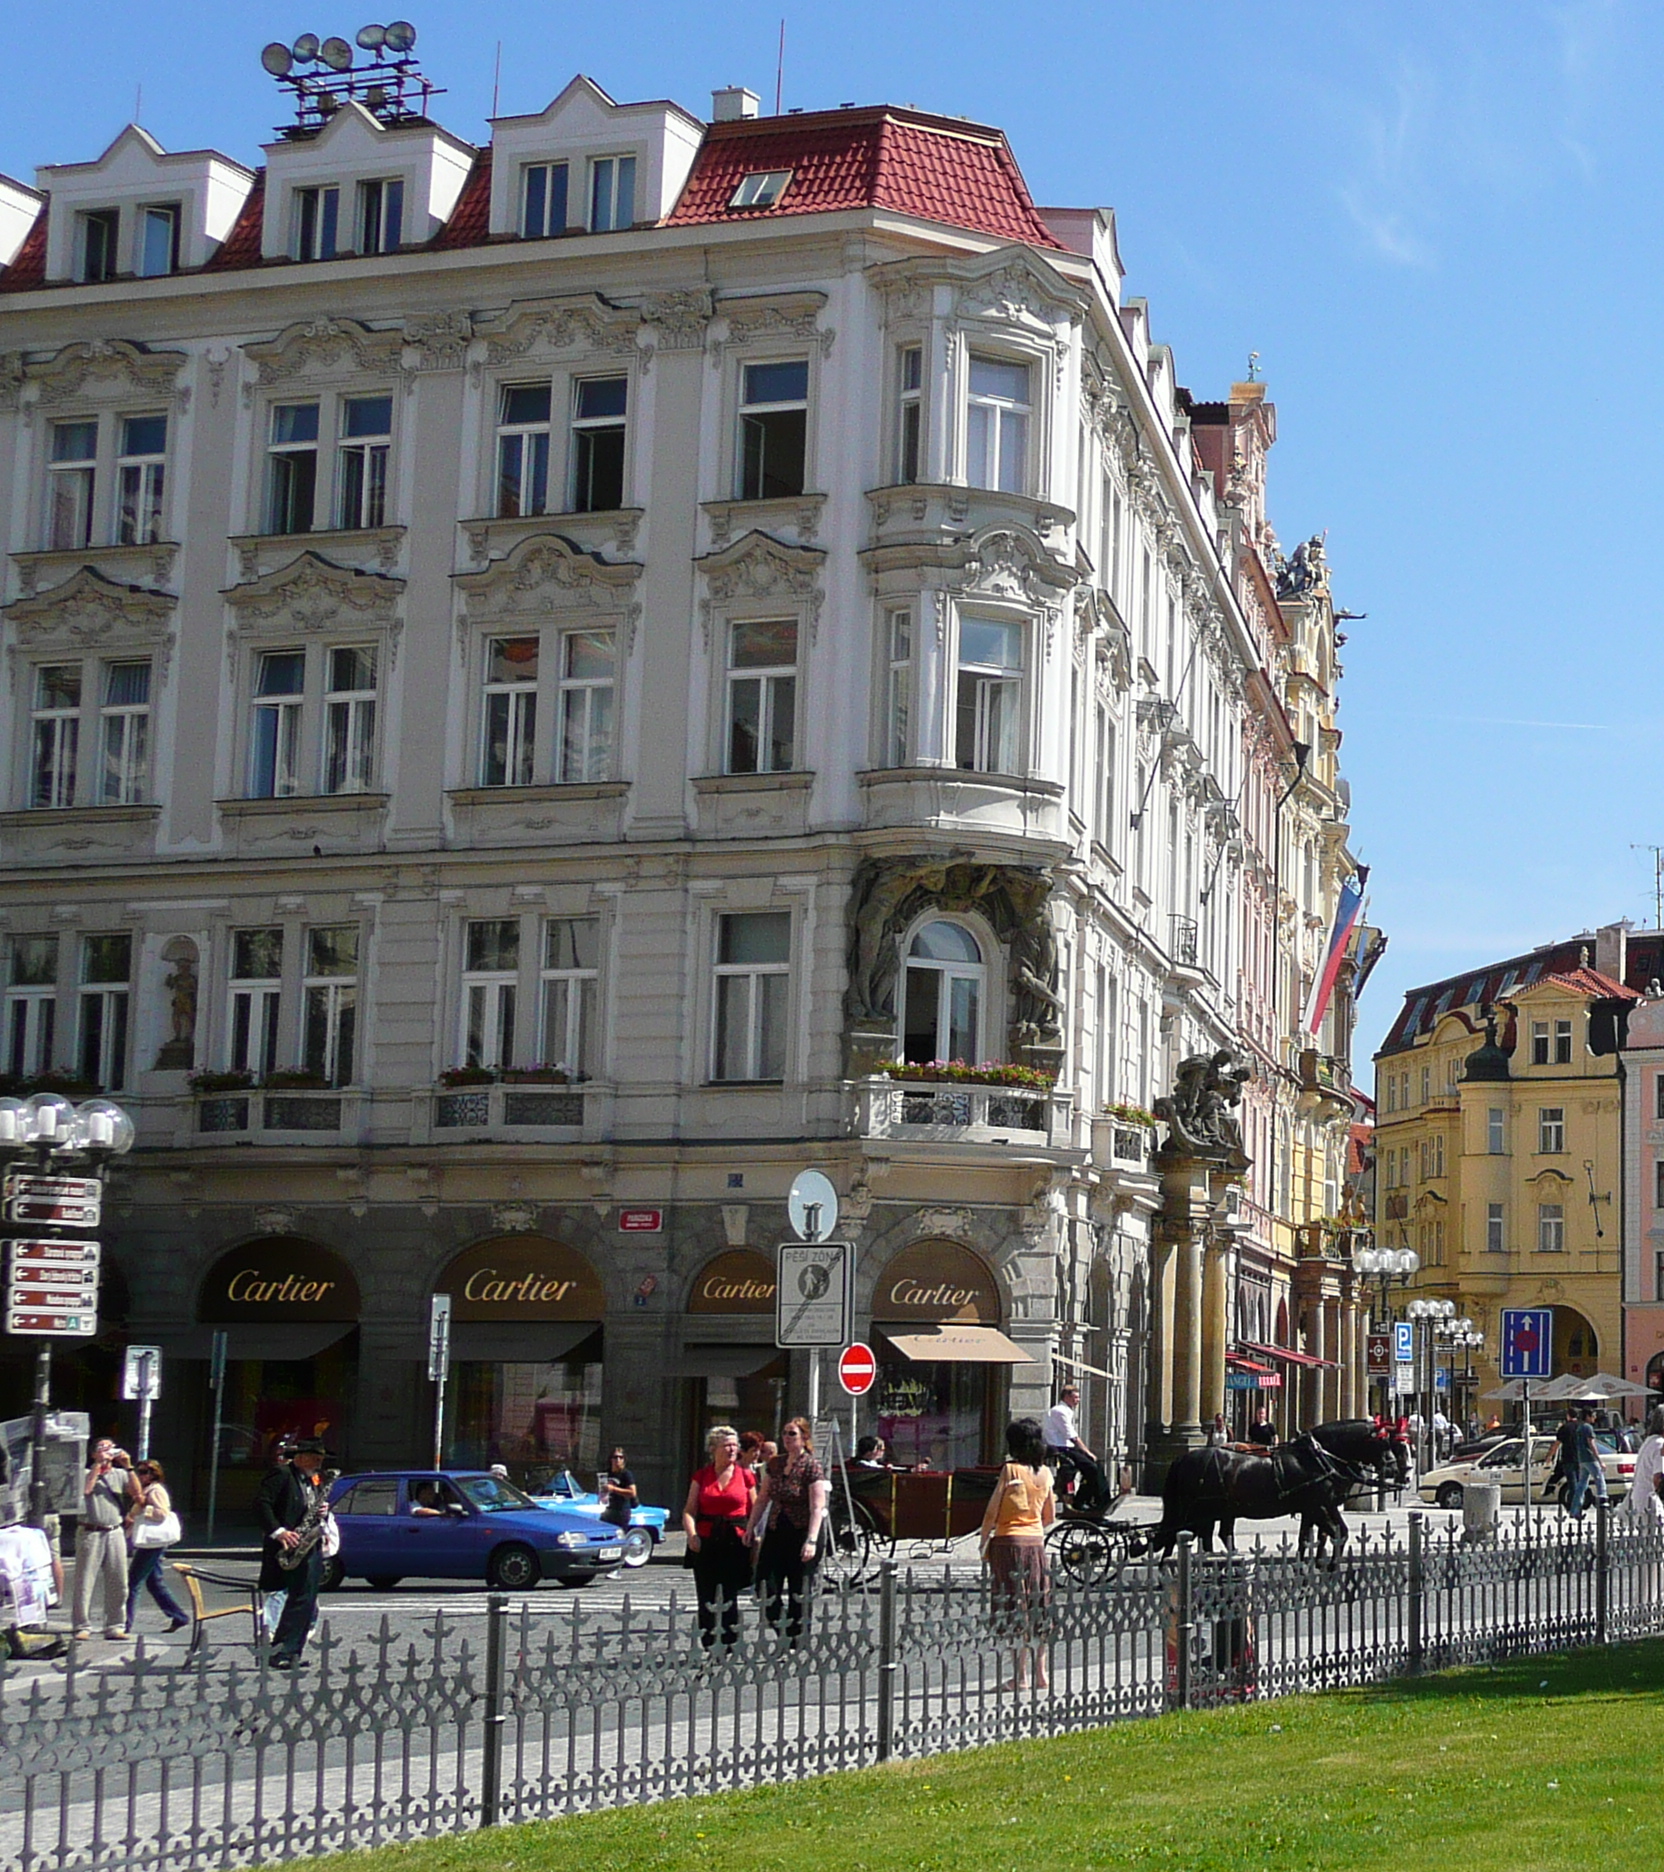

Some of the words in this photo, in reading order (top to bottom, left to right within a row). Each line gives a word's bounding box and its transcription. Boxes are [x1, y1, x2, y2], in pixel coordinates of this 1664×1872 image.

[228, 1268, 336, 1302] Cartier
[464, 1268, 577, 1302] Cartier
[703, 1276, 778, 1299] Cartier
[890, 1279, 980, 1306] Cartier
[1398, 1328, 1409, 1348] P
